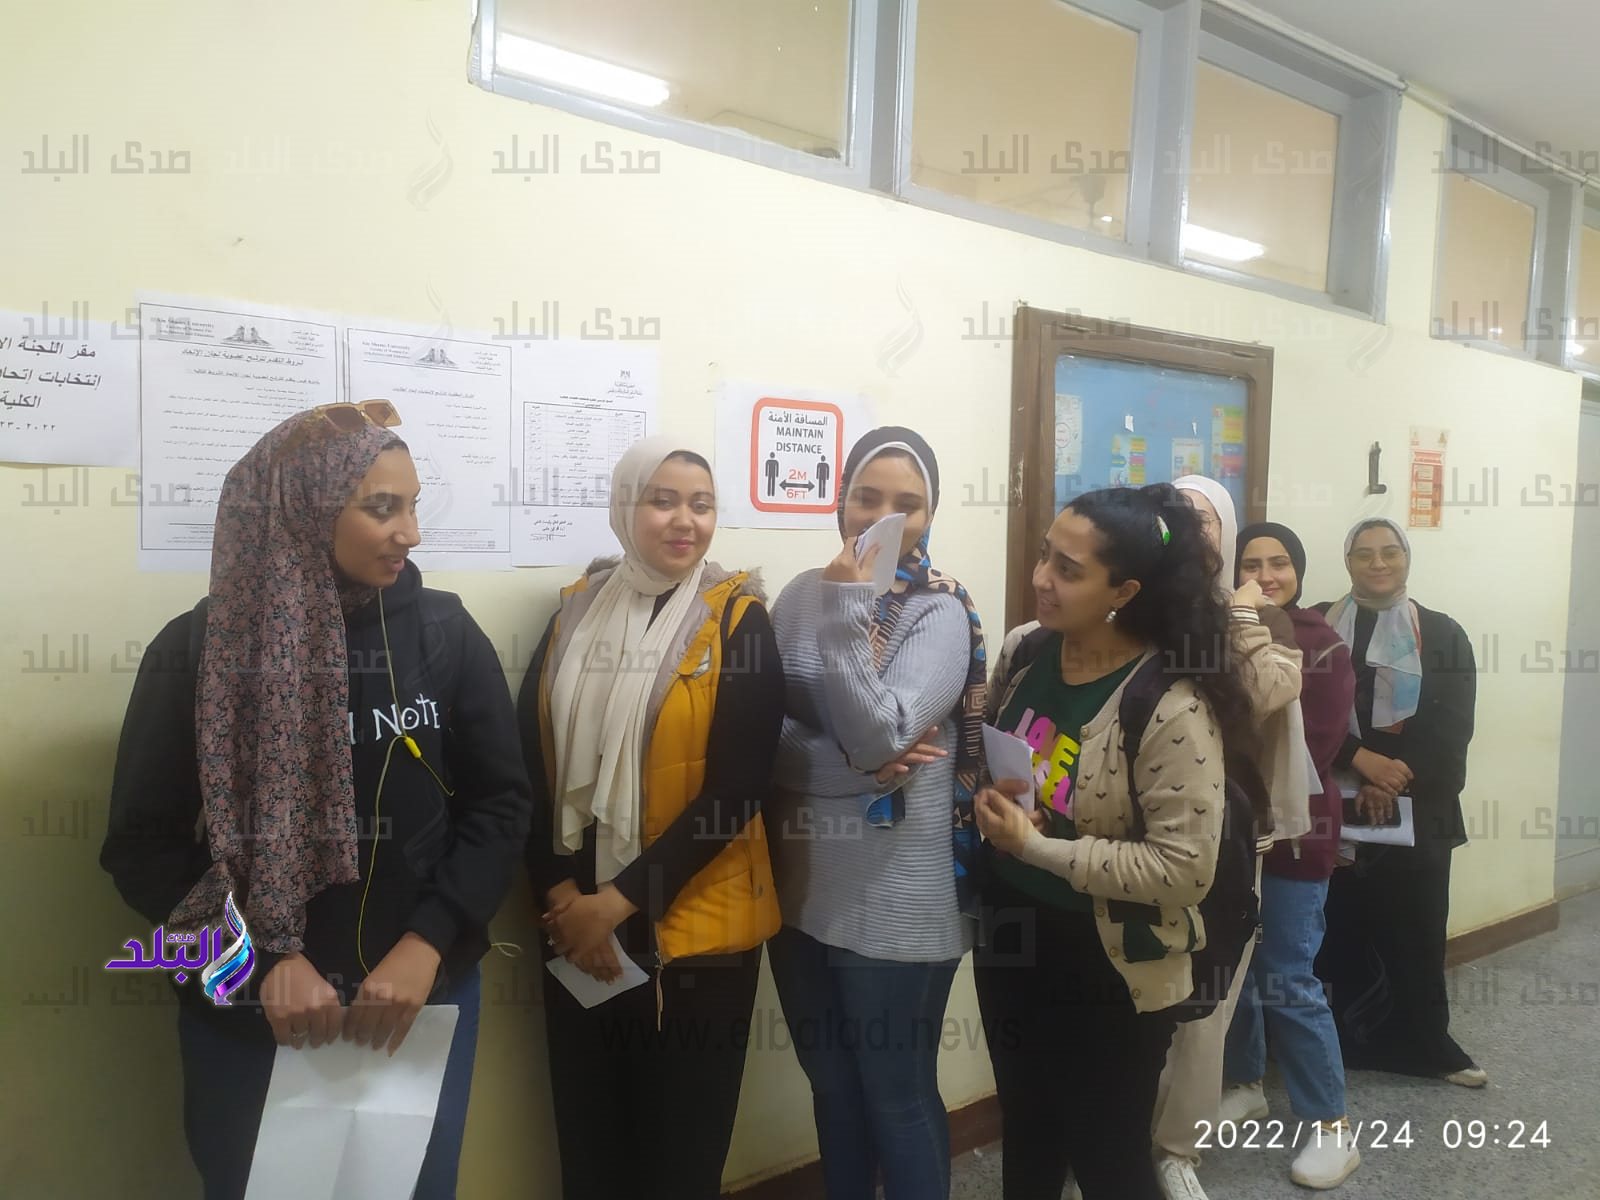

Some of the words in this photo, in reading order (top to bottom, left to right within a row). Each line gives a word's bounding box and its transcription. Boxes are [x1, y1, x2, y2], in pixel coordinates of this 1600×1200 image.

[18, 336, 64, 356] اللجنة
[67, 344, 96, 360] مقر
[38, 371, 102, 391] إنتخابات
[794, 412, 828, 426] المسافة
[776, 426, 824, 439] MAINTAIN
[776, 442, 822, 454] DISTANCE
[788, 469, 807, 481] 2M
[786, 489, 808, 500] 6FT
